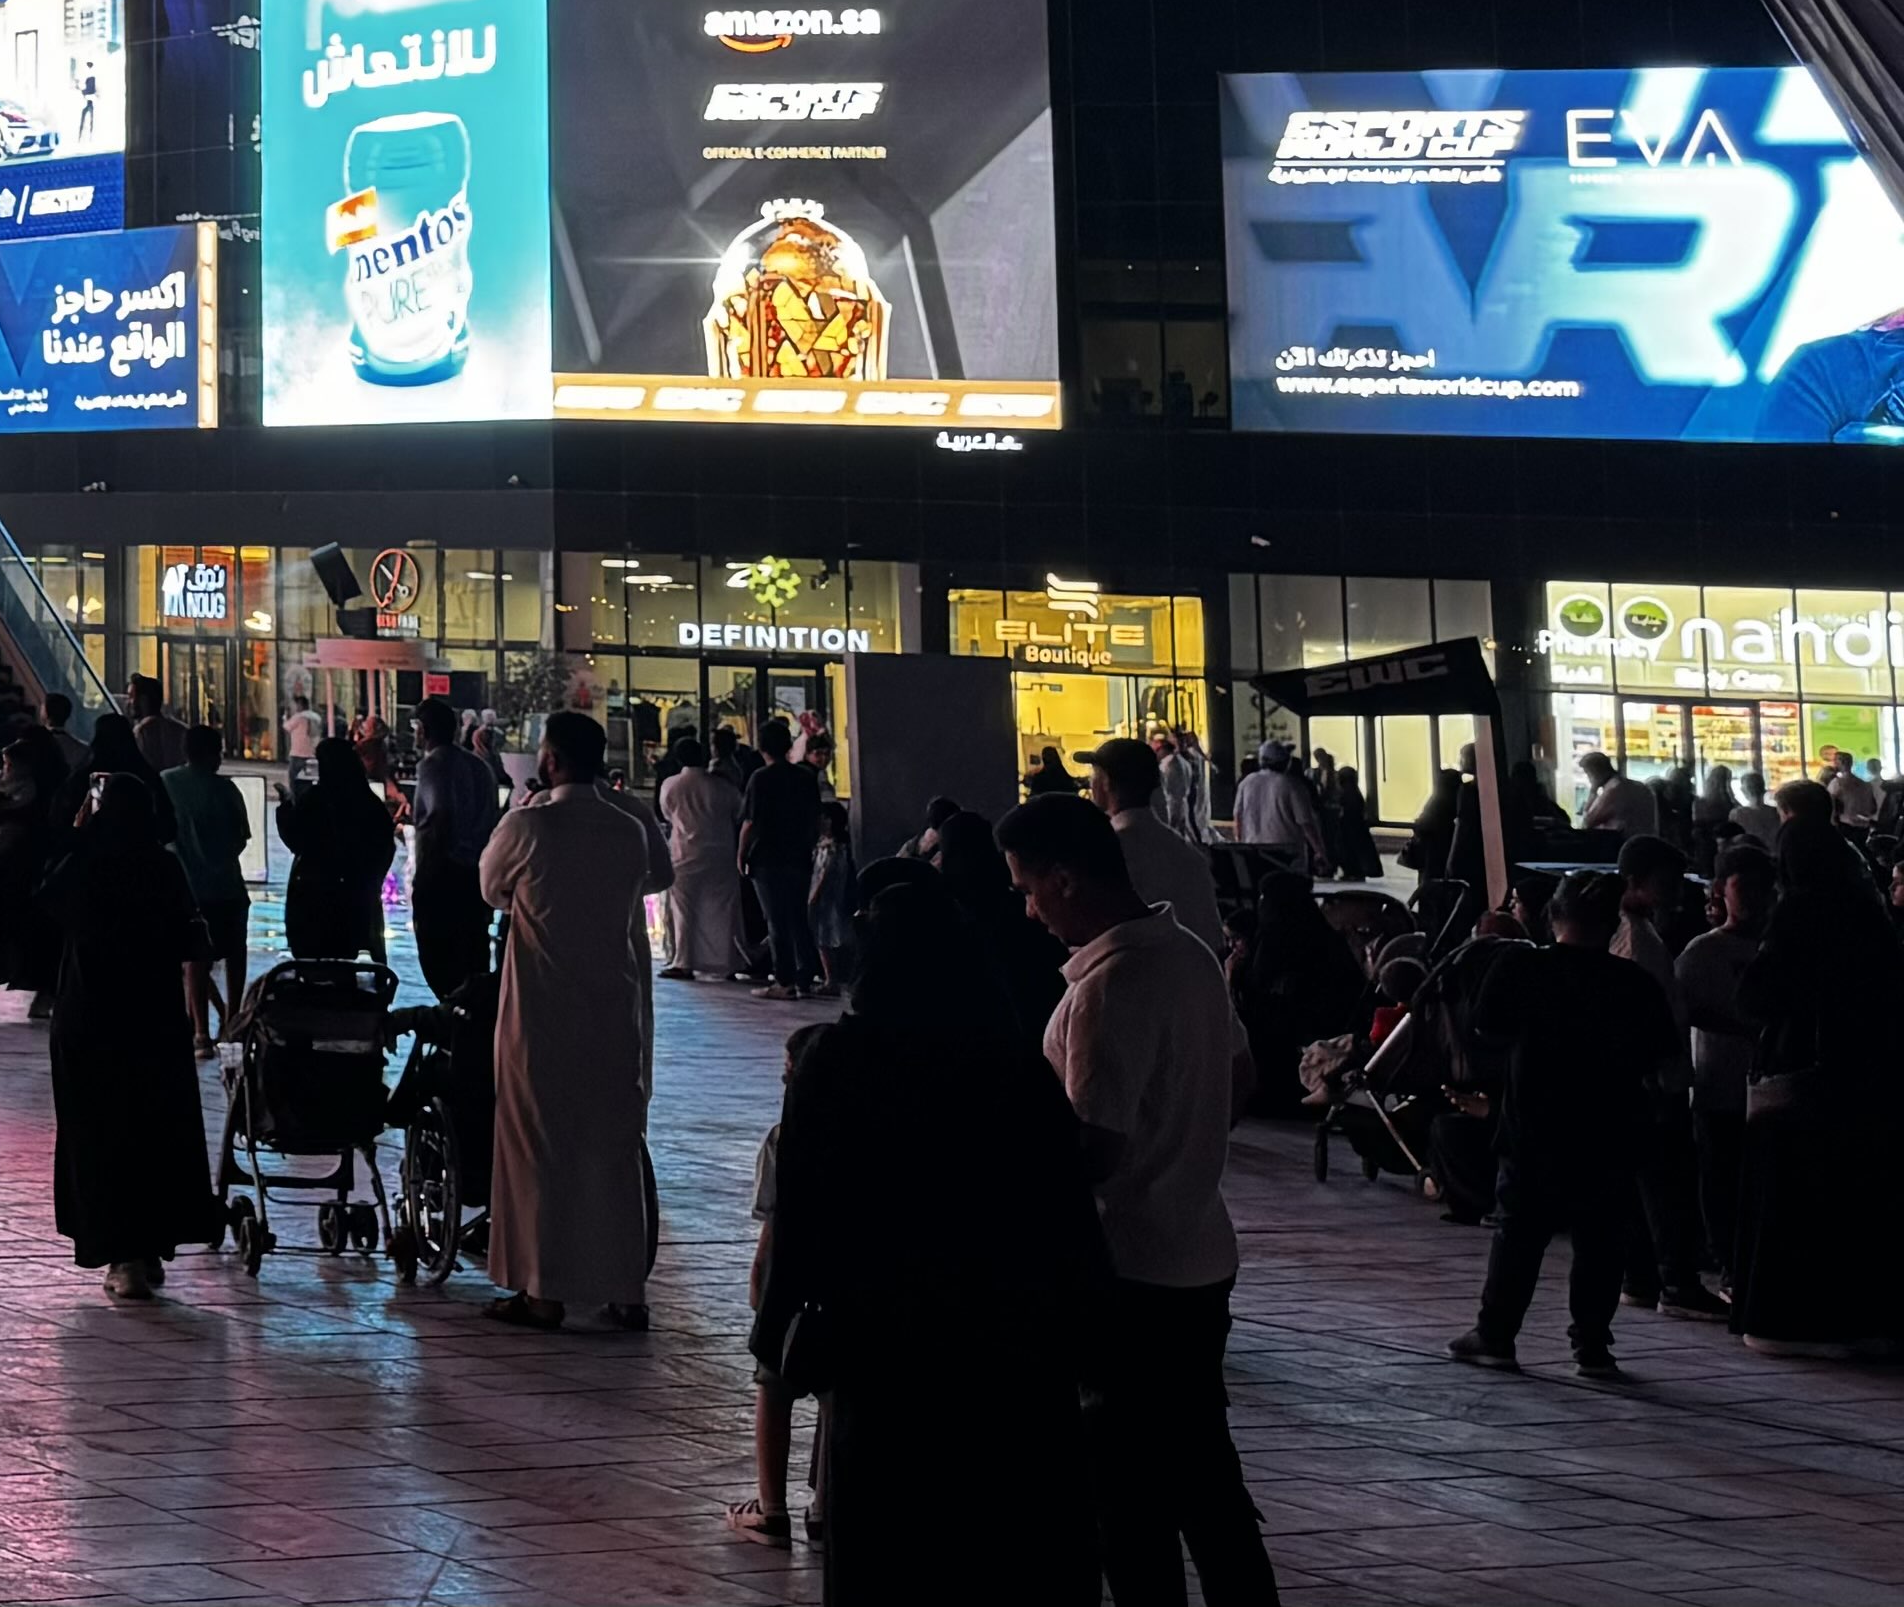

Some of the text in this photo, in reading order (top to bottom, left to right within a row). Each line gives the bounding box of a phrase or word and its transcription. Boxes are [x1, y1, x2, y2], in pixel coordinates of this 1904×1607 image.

[704, 8, 882, 37] amazon.sa
[302, 24, 497, 109] للانتعاش
[1276, 136, 1516, 160] WORLD CUP
[1286, 108, 1744, 168] ESPORTS EVA
[51, 270, 186, 323] اكسر حاجز
[42, 319, 187, 377] الواقع عندنا
[1276, 376, 1580, 400] www.esportsworldcup.com
[678, 622, 869, 653] DEFINITION
[1025, 644, 1112, 668] Boutique
[1680, 607, 1904, 668] nahdi
[1304, 652, 1450, 699] EWC
